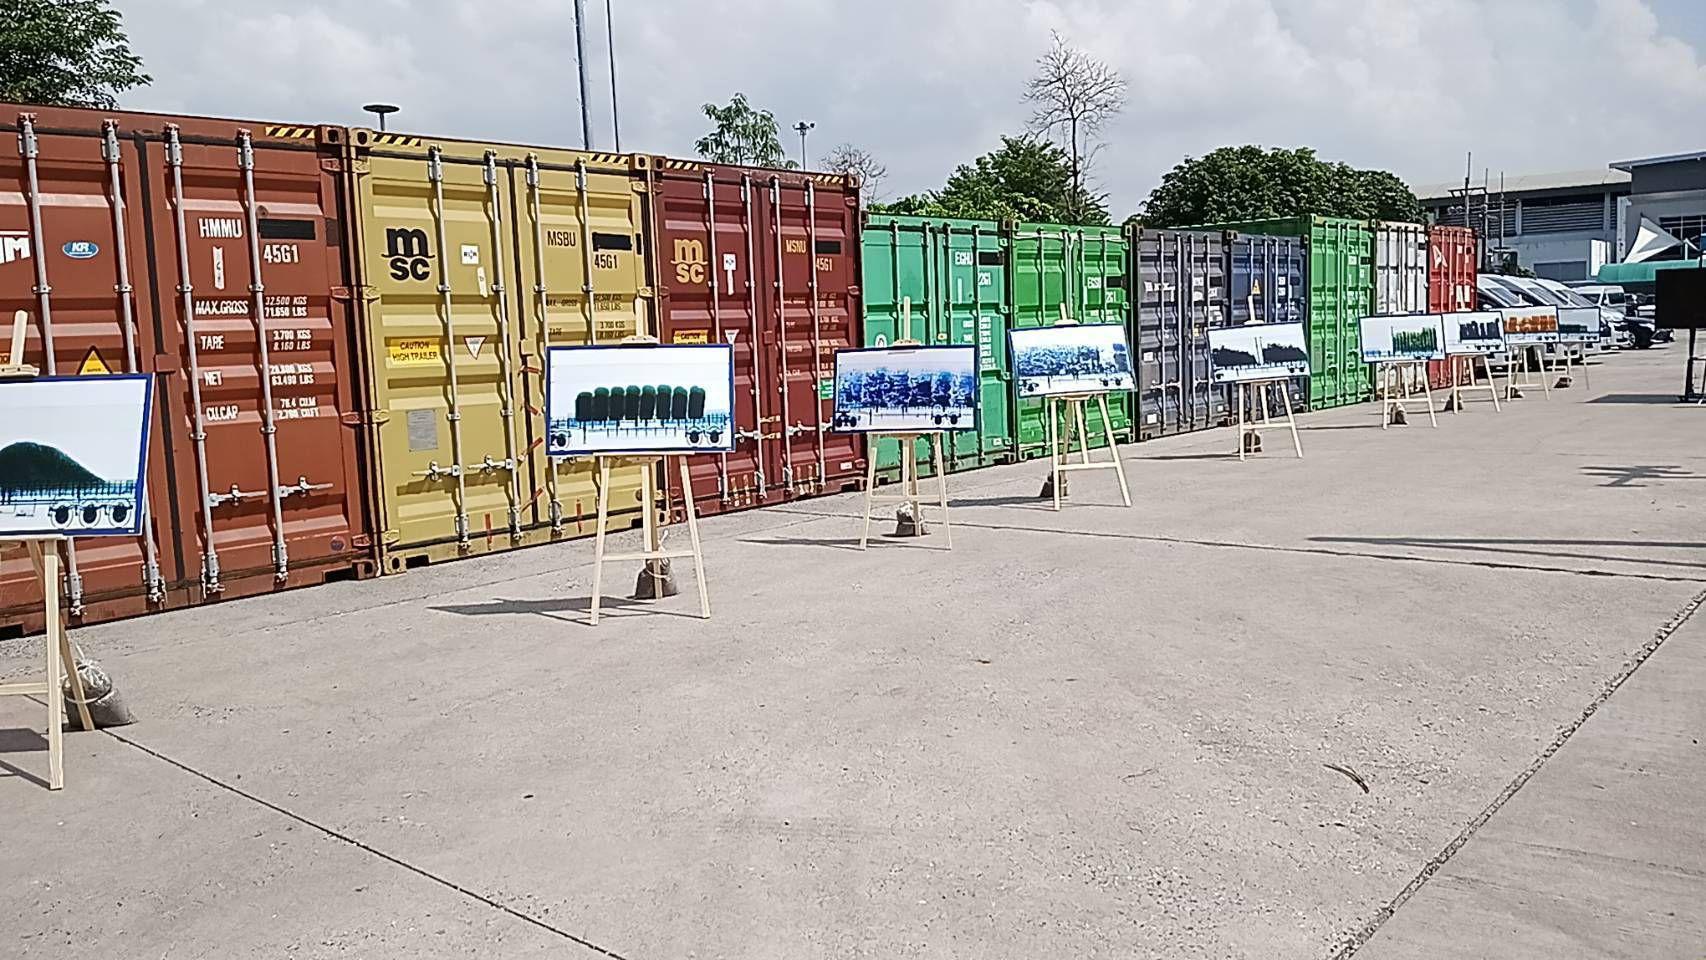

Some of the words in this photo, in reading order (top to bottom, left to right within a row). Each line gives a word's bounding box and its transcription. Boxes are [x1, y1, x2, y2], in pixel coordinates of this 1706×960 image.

[198, 218, 243, 238] HMMU
[547, 230, 576, 247] MSBU
[71, 242, 89, 252] KR
[263, 244, 299, 263] 45G1
[594, 254, 618, 269] 45G1
[292, 306, 308, 316] LBS
[200, 335, 224, 350] TARE
[296, 341, 311, 350] LBS
[399, 341, 430, 350] CAUTION
[392, 351, 410, 361] HIGH
[410, 350, 439, 361] TRAILER
[203, 371, 222, 386] NET
[299, 374, 314, 385] LBS
